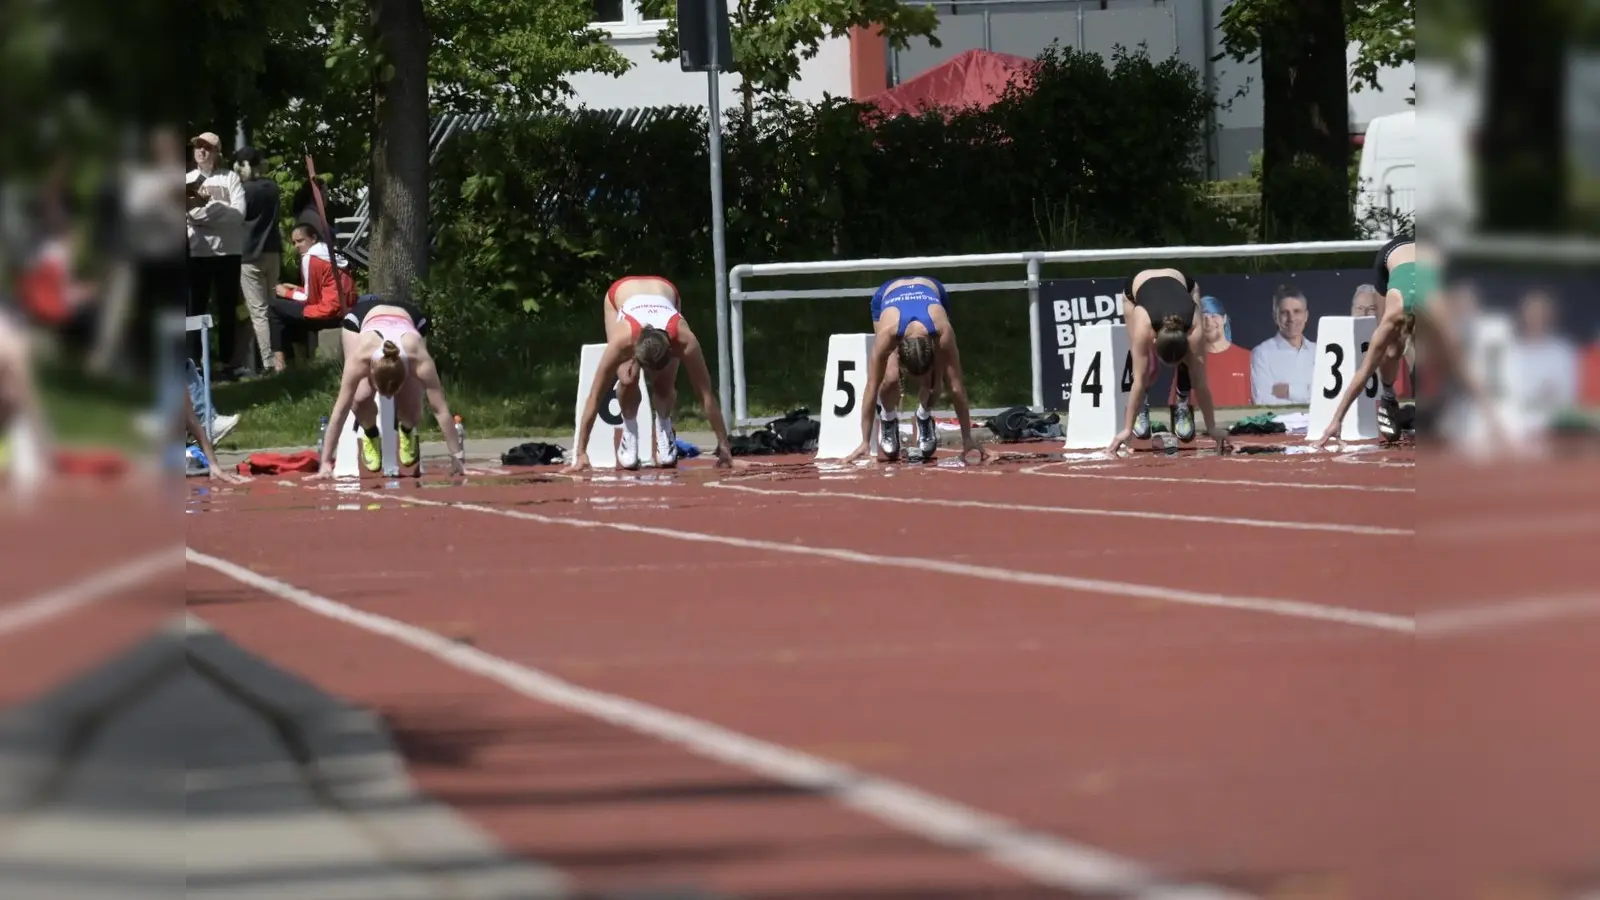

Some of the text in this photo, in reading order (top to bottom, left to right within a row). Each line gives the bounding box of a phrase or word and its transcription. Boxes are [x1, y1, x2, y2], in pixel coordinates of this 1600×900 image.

[833, 360, 856, 418] 5
[1081, 351, 1103, 408] 4
[1323, 342, 1344, 399] 3
